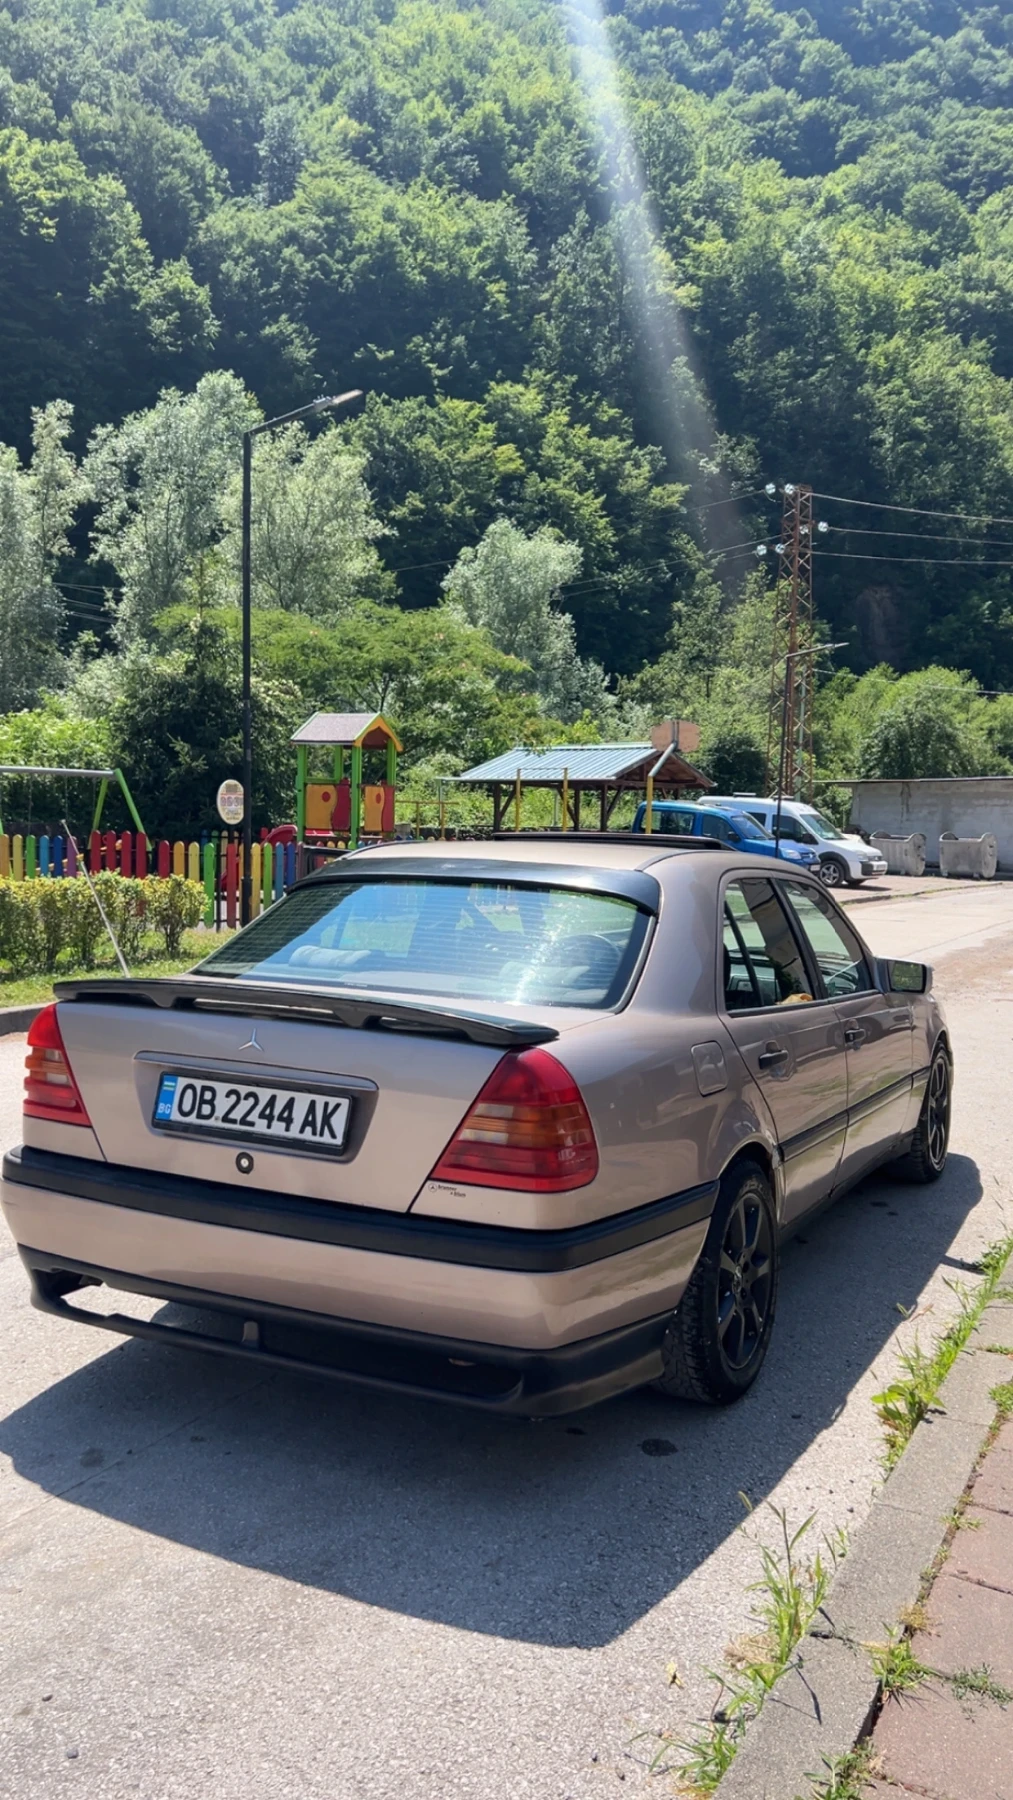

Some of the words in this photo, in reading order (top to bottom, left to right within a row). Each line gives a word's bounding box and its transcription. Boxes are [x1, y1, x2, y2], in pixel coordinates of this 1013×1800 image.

[157, 1102, 172, 1115] BG
[177, 1083, 217, 1121] OB
[221, 1088, 296, 1133] 2244
[299, 1099, 342, 1140] AK
